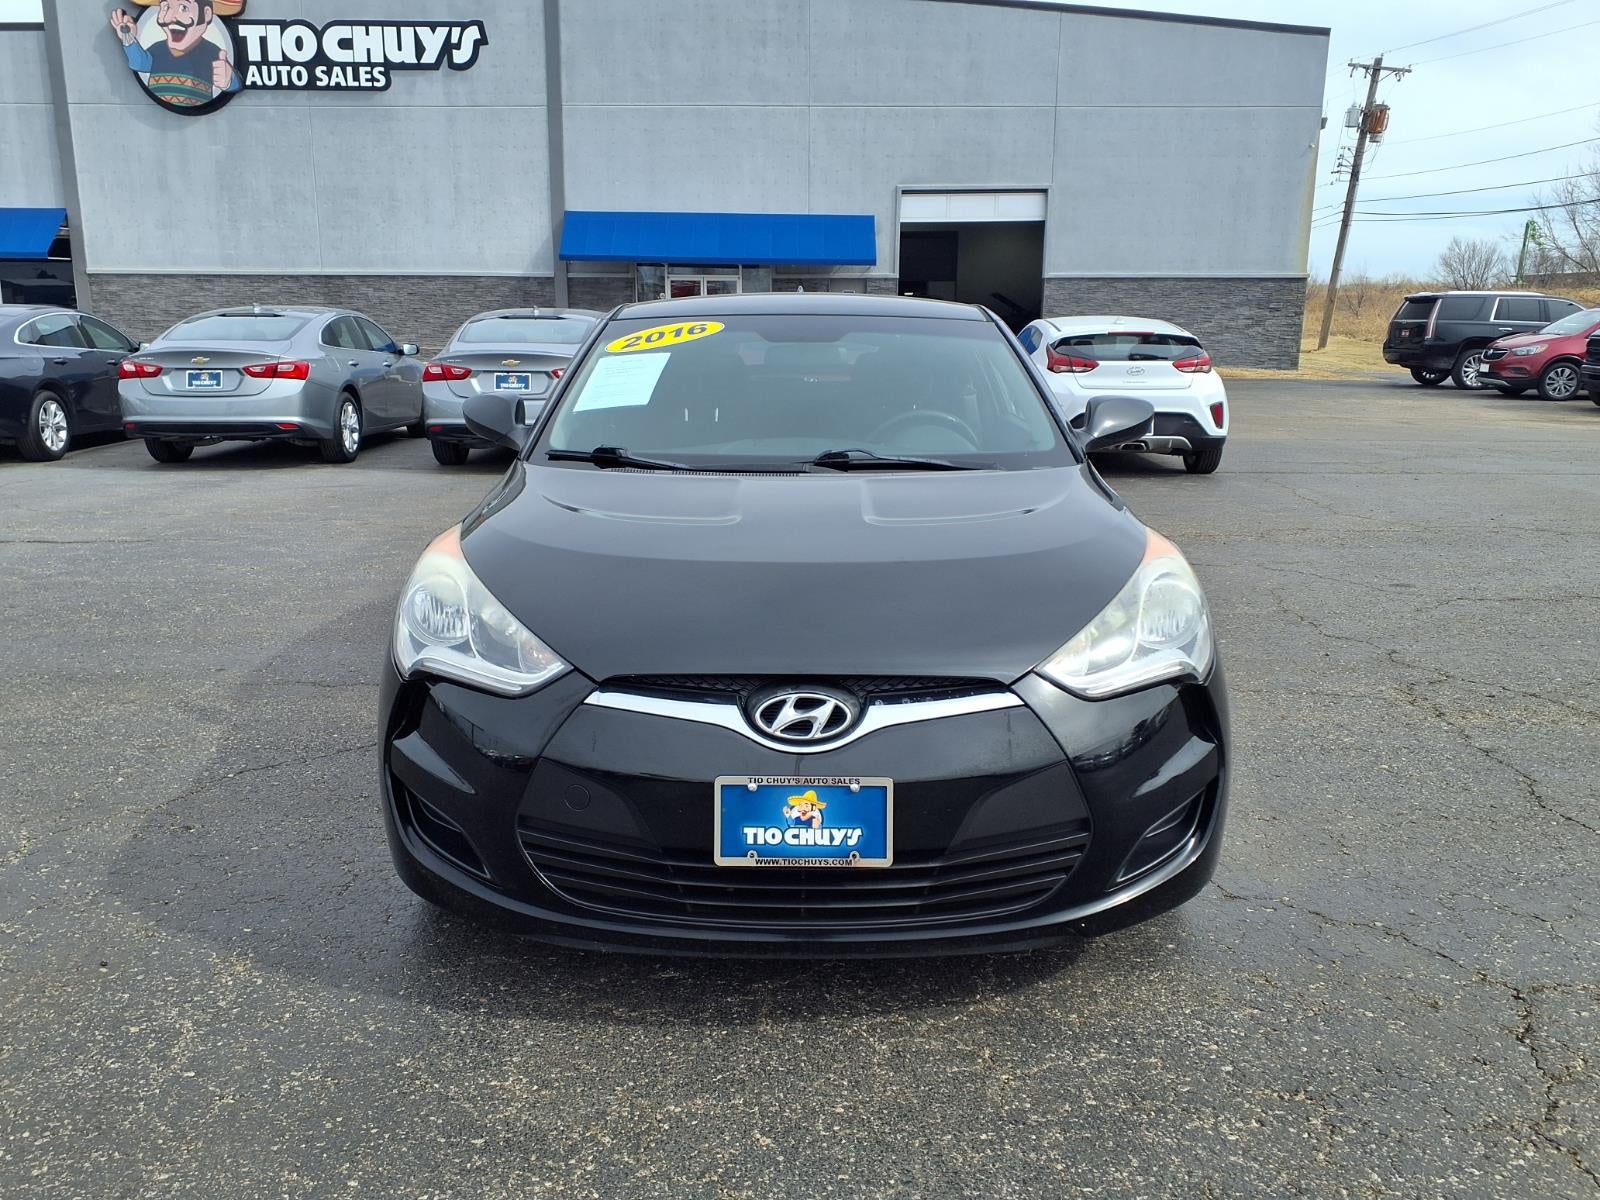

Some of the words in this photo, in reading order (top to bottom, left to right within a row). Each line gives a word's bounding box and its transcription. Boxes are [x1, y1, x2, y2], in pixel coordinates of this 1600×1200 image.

[238, 24, 318, 63] TIO
[322, 24, 481, 64] CHUY'S
[245, 66, 309, 87] AUTO
[316, 66, 386, 87] SALES
[622, 323, 708, 350] 2016
[766, 777, 800, 785] CHUY'S
[803, 777, 828, 785] AUTO
[831, 777, 861, 785] SALES
[744, 828, 782, 845] TIO
[784, 828, 863, 846] CHUY'S
[755, 857, 853, 866] WWW.TIOCHUYS.COM
